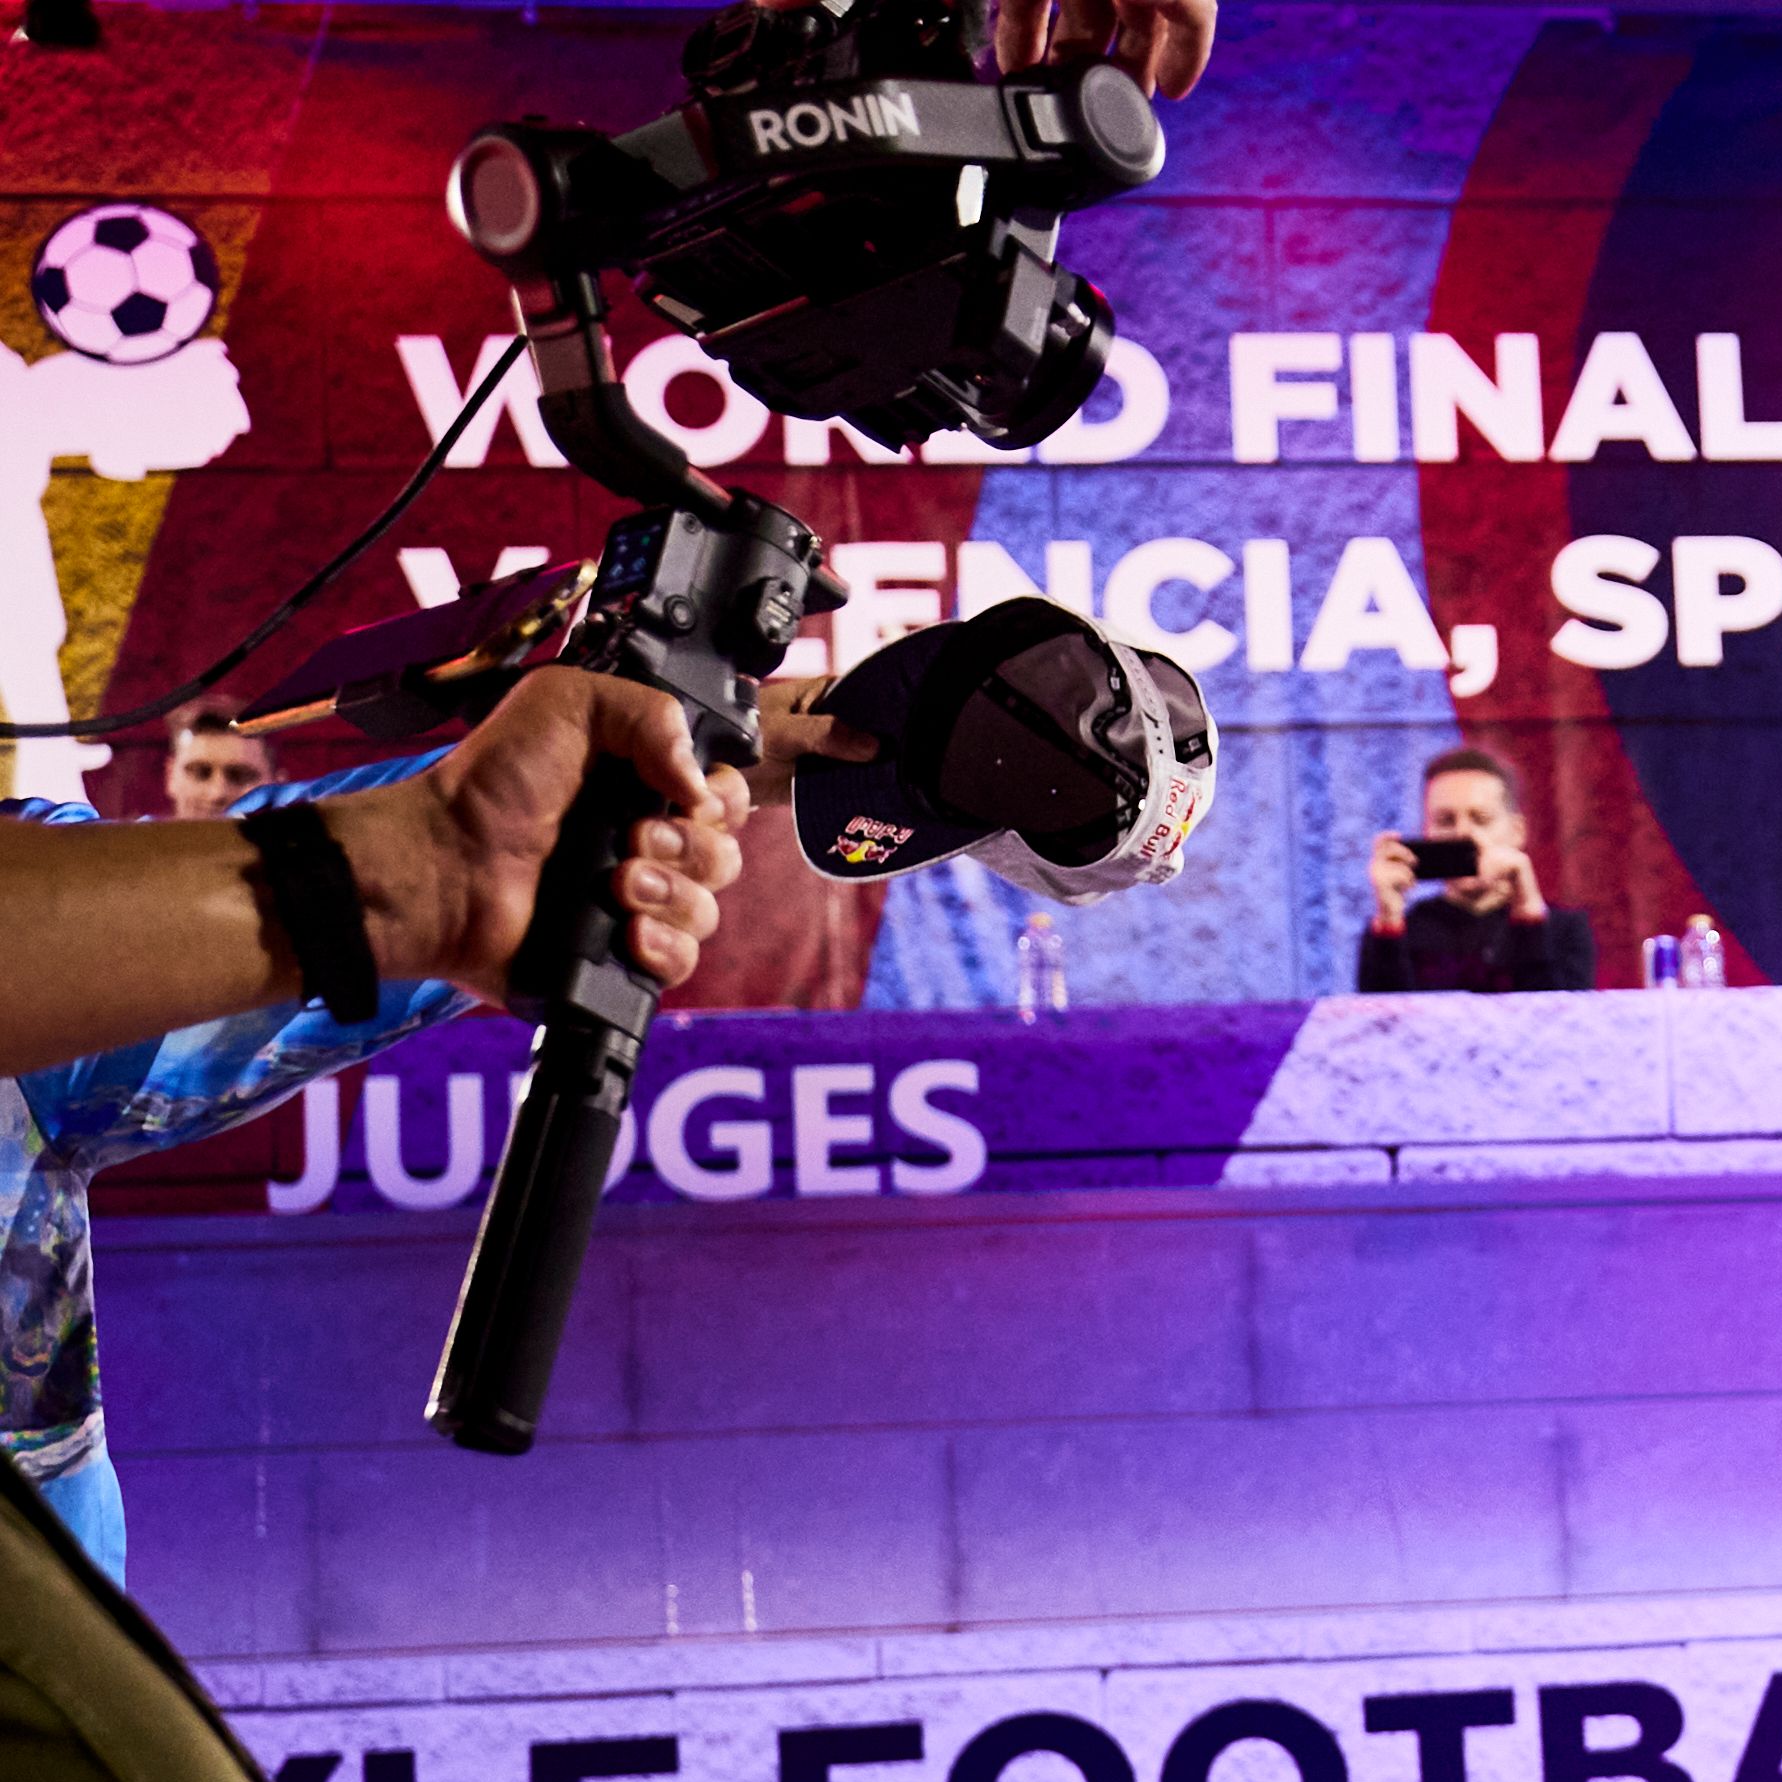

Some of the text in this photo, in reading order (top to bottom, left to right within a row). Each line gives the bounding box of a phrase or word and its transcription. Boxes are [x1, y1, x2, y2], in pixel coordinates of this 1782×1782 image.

[749, 91, 922, 156] RONIN
[1165, 775, 1188, 820] Red
[1139, 822, 1171, 860] Bull
